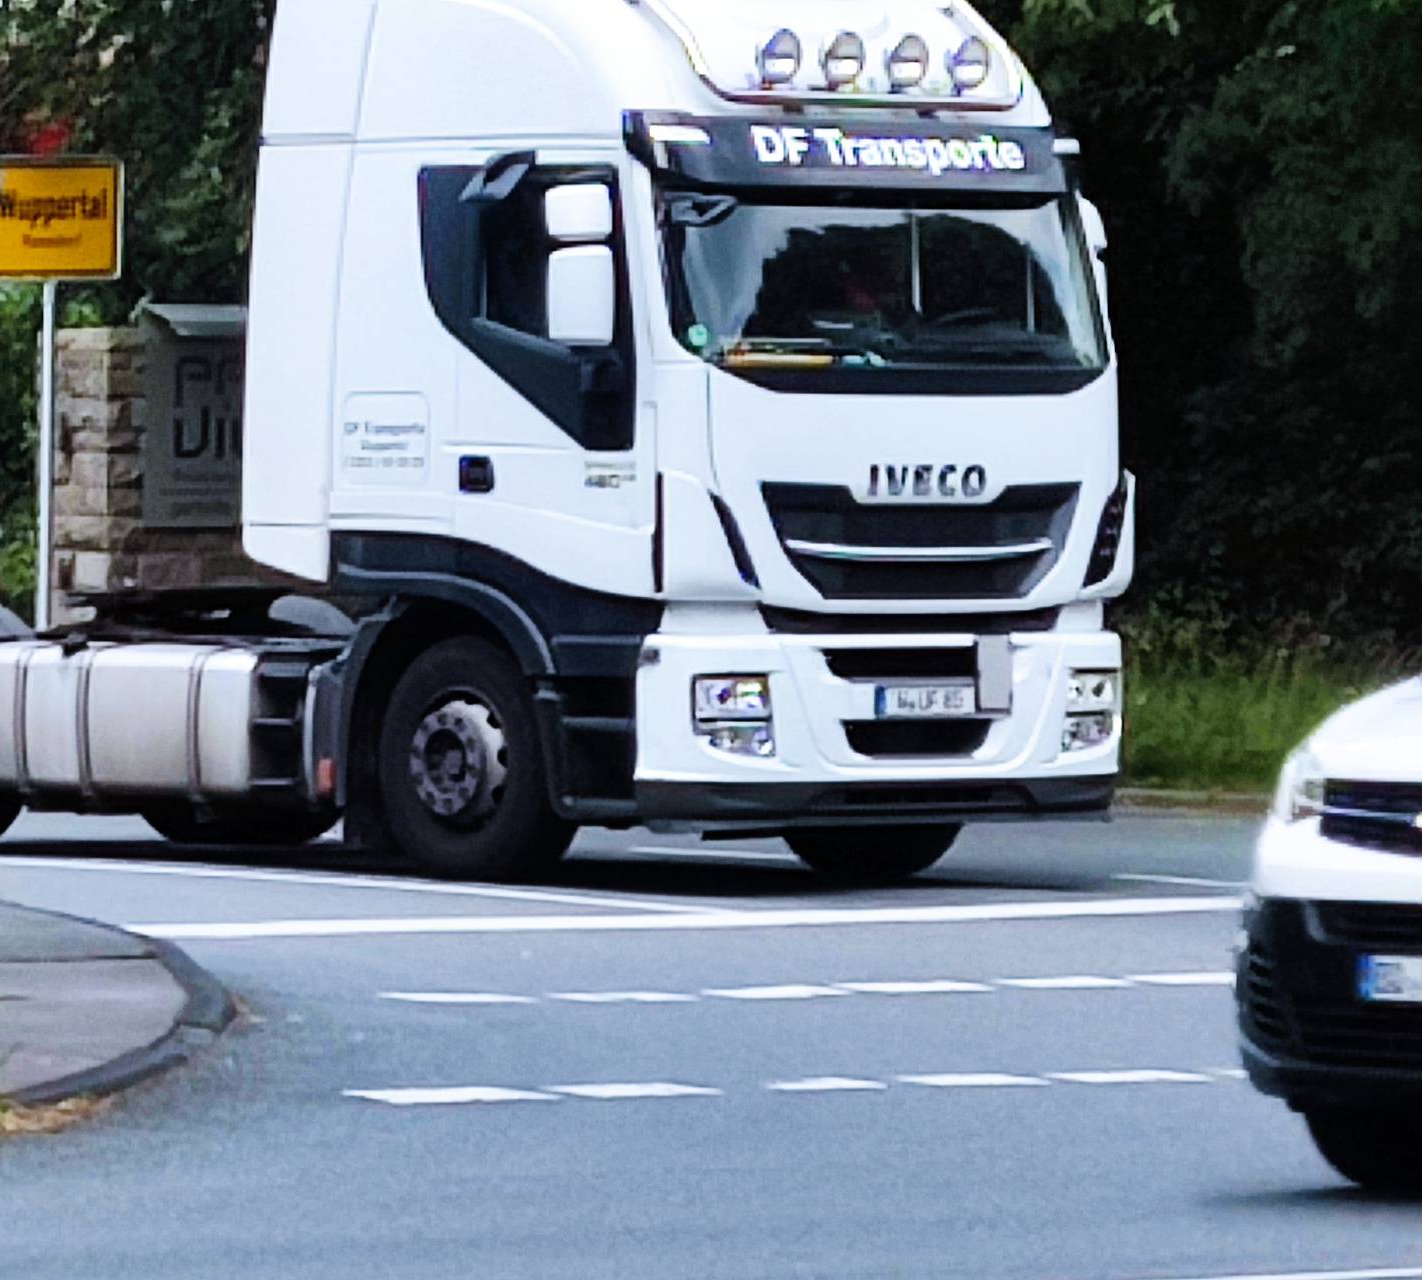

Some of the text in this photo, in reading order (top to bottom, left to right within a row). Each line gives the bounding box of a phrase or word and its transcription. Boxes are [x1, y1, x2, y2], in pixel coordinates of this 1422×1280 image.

[750, 125, 1026, 176] DF Transporte
[867, 464, 987, 498] IVECO
